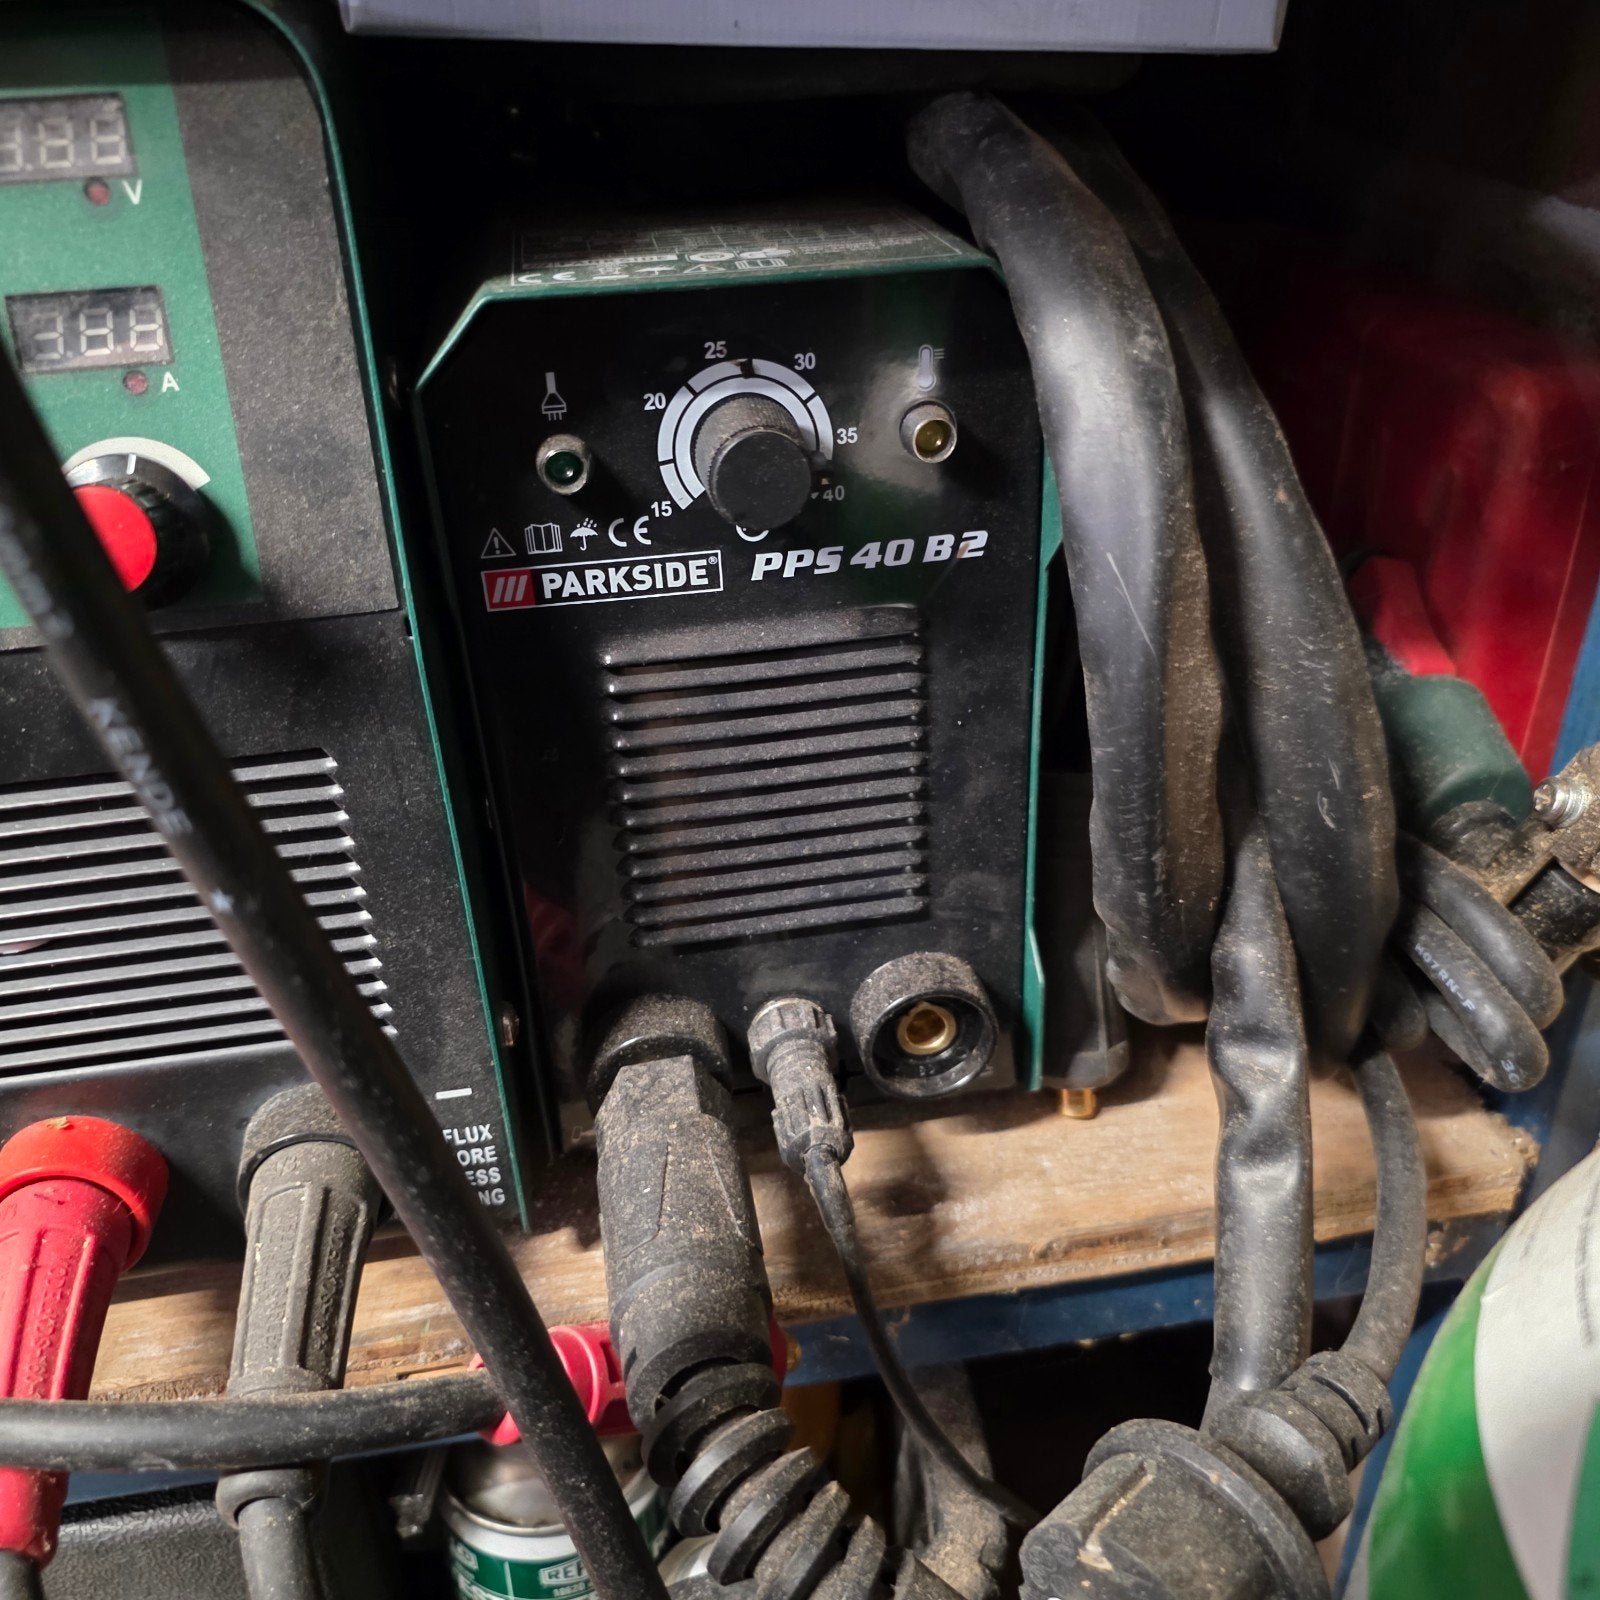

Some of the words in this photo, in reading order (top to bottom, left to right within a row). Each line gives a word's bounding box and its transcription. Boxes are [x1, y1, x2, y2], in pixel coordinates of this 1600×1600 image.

[122, 179, 143, 205] V
[704, 341, 728, 359] 25
[794, 352, 816, 370] 30
[161, 371, 181, 392] A
[643, 392, 666, 411] 20
[836, 427, 858, 445] 35
[822, 485, 845, 502] 40
[650, 500, 673, 518] 15
[750, 545, 844, 581] PPS
[850, 538, 915, 570] 40
[922, 530, 989, 563] B2
[541, 558, 709, 599] PARKSIDE
[442, 1123, 493, 1146] FLUX
[456, 1145, 498, 1167] ORE
